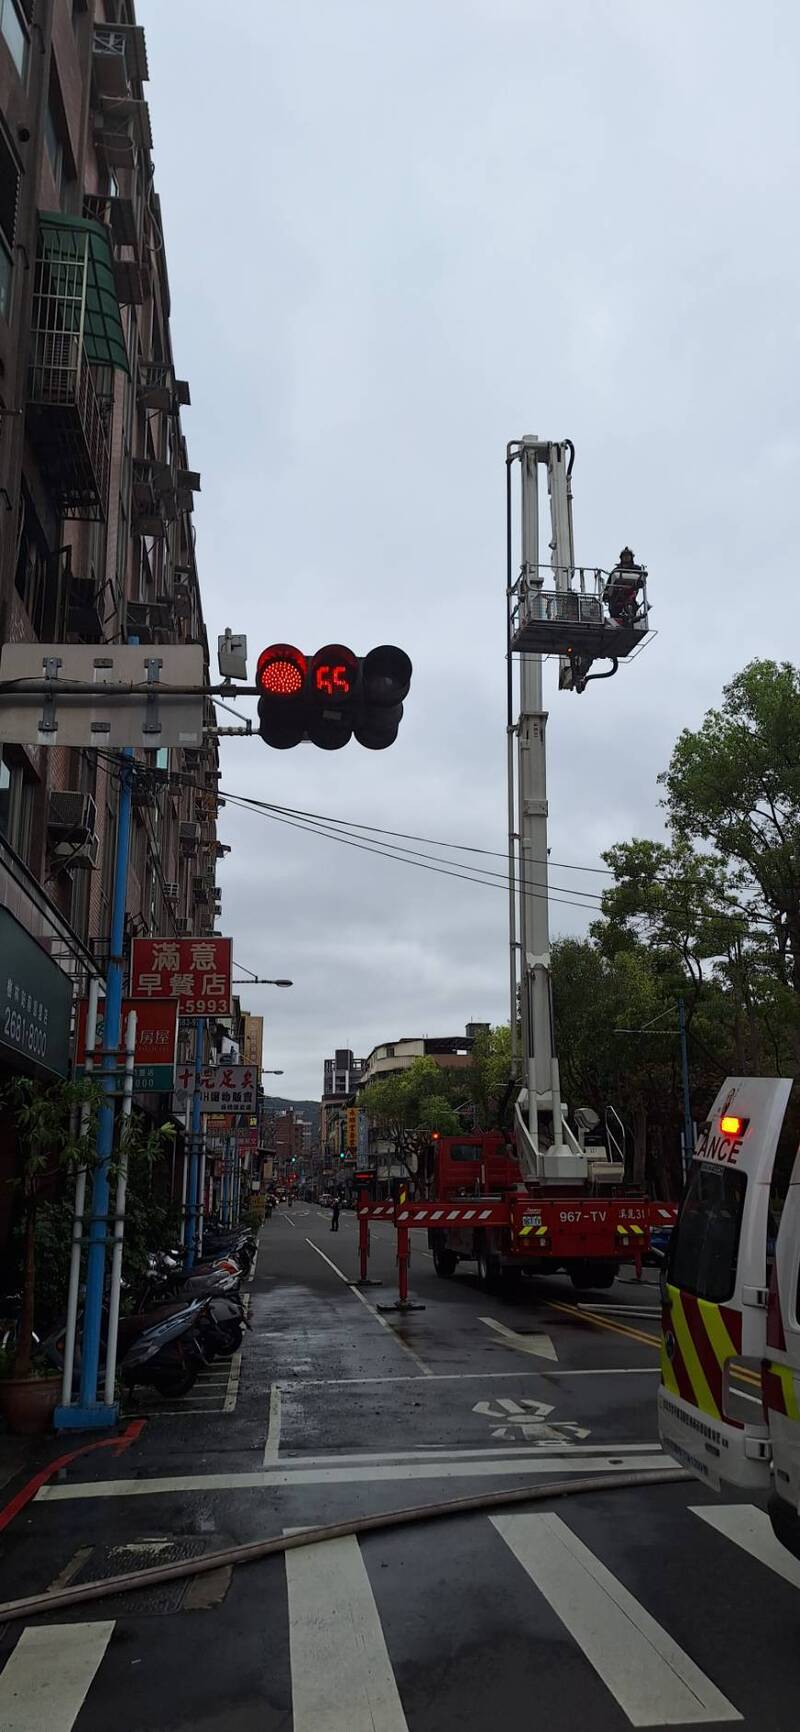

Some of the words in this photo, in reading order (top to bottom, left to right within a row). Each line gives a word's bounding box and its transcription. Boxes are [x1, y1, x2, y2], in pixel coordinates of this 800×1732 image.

[152, 942, 217, 971] 滿意
[136, 973, 227, 997] 早餐店
[694, 1136, 743, 1164] ANCE
[559, 1210, 607, 1223] 967-TV
